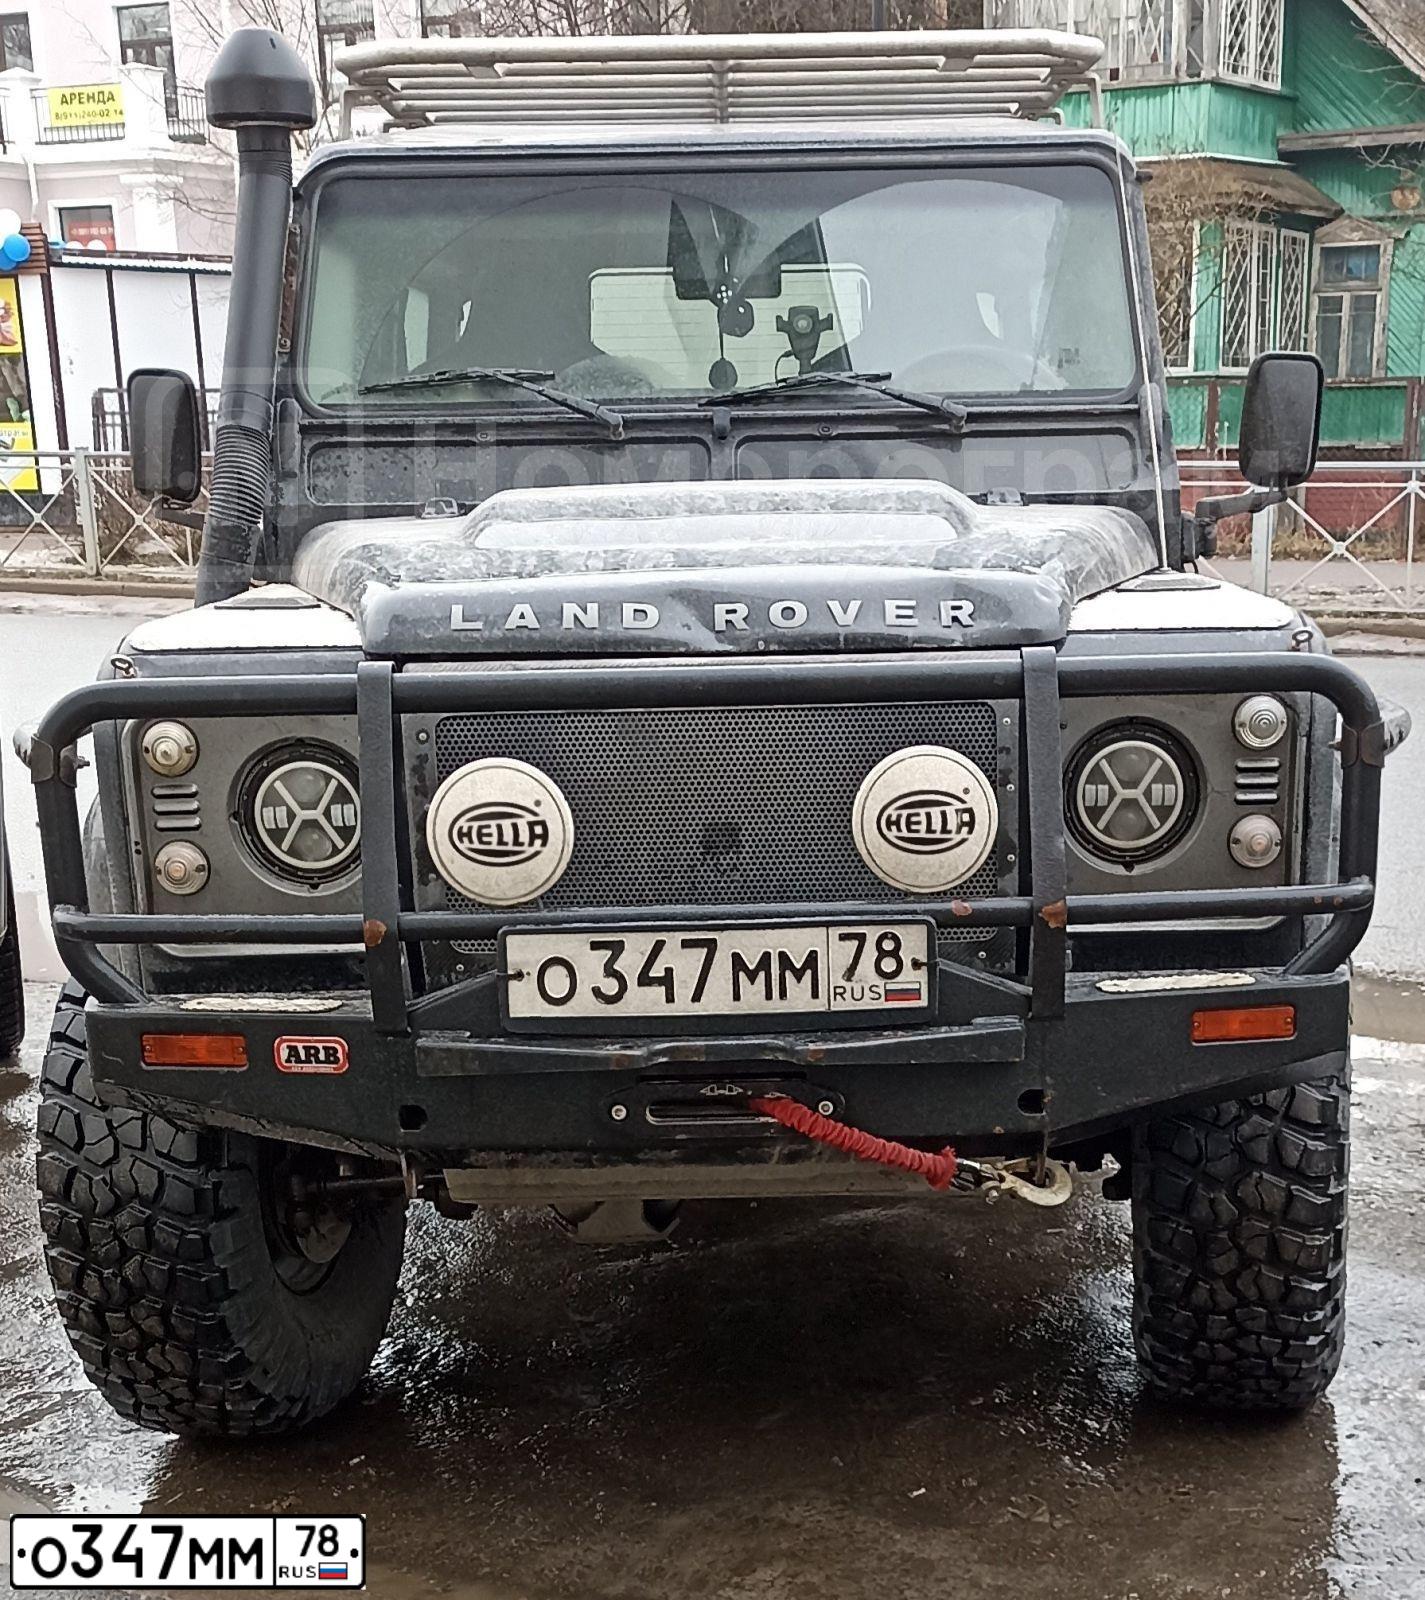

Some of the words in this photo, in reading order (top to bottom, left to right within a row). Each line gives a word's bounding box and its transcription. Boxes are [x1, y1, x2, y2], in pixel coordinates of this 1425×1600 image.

[60, 90, 115, 105] АРЕНДА
[450, 601, 659, 632] LAND
[714, 598, 976, 632] ROVER
[457, 819, 549, 847] HELLA
[885, 807, 975, 835] HELLA
[838, 931, 904, 981] 78
[833, 985, 882, 1001] RUS
[285, 1045, 340, 1064] ARB
